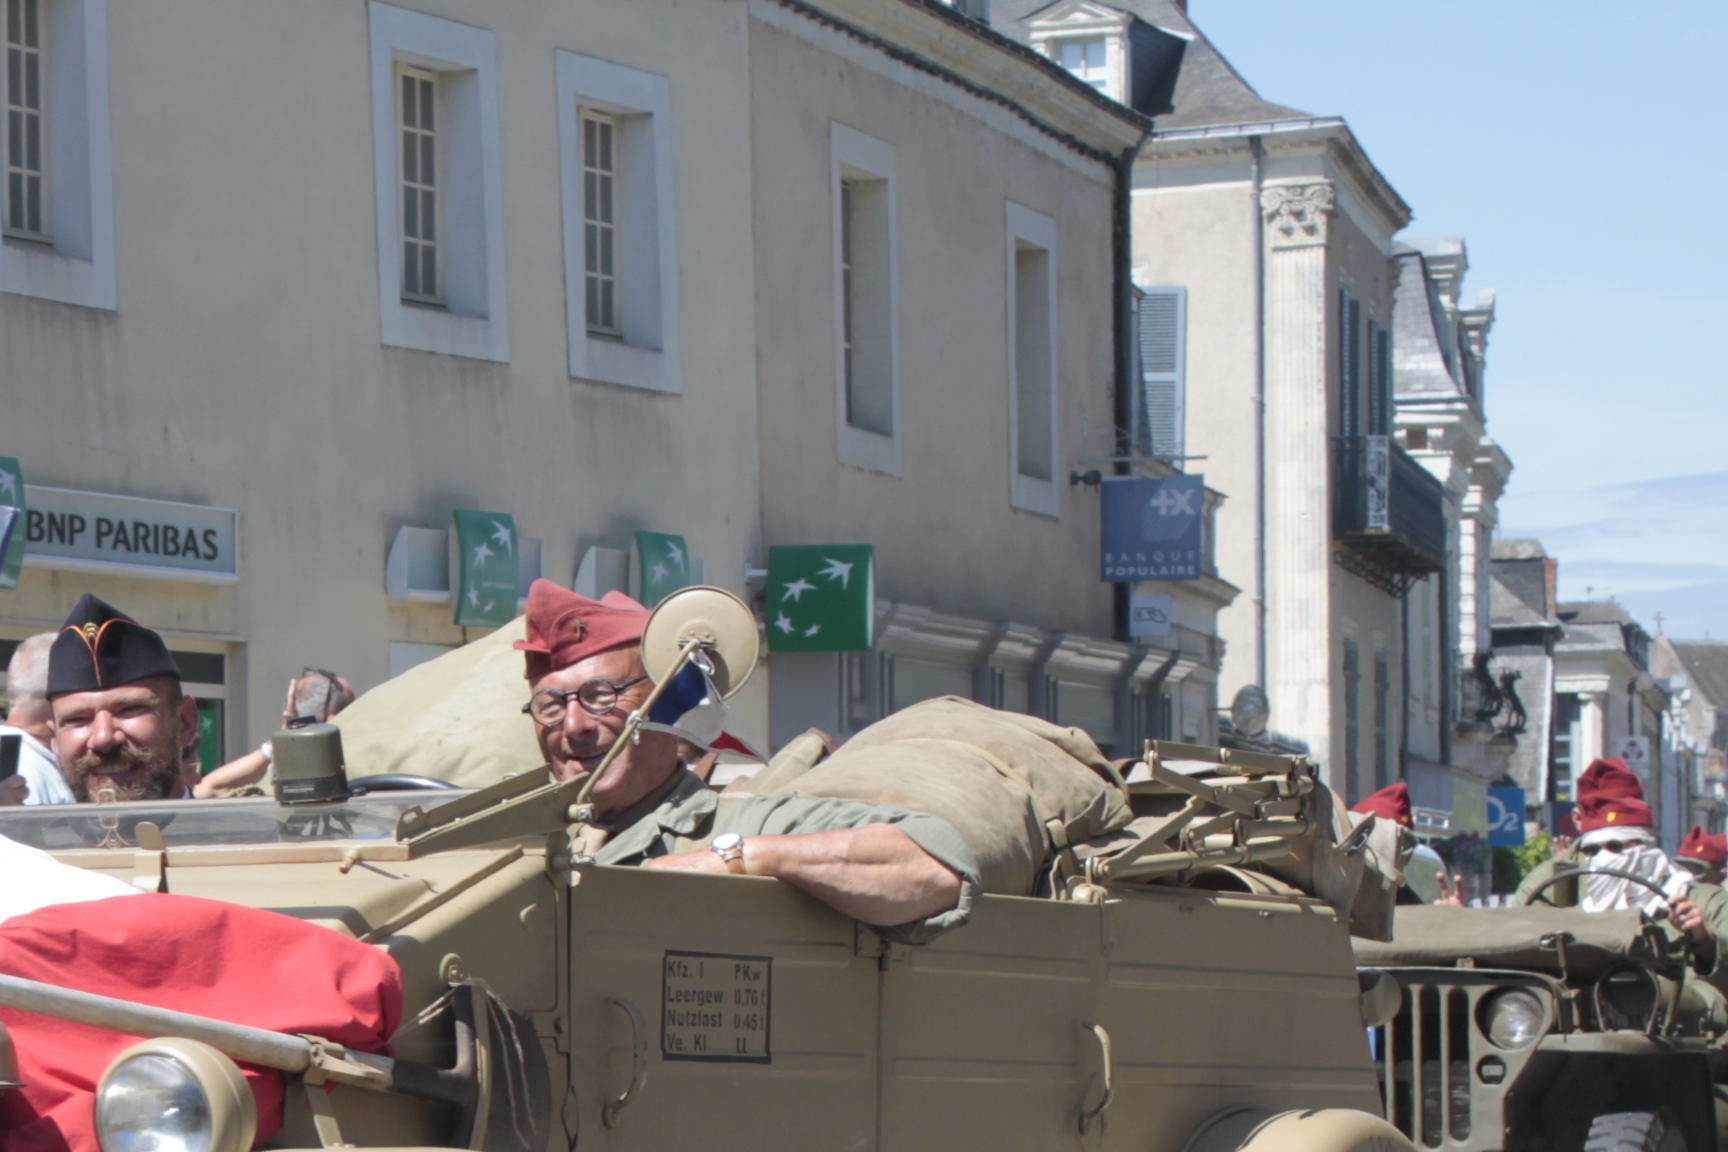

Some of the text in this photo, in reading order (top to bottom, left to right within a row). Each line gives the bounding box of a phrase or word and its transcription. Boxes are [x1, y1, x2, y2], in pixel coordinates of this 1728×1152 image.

[25, 509, 219, 561] BNP PARIBAS
[1105, 551, 1194, 563] BANQUE
[1105, 565, 1195, 577] POPULAIRE
[667, 960, 692, 978] Kfz.
[667, 985, 726, 1006] Leergew.
[667, 1008, 723, 1028] Nutzlast
[667, 1033, 687, 1051] Ve.
